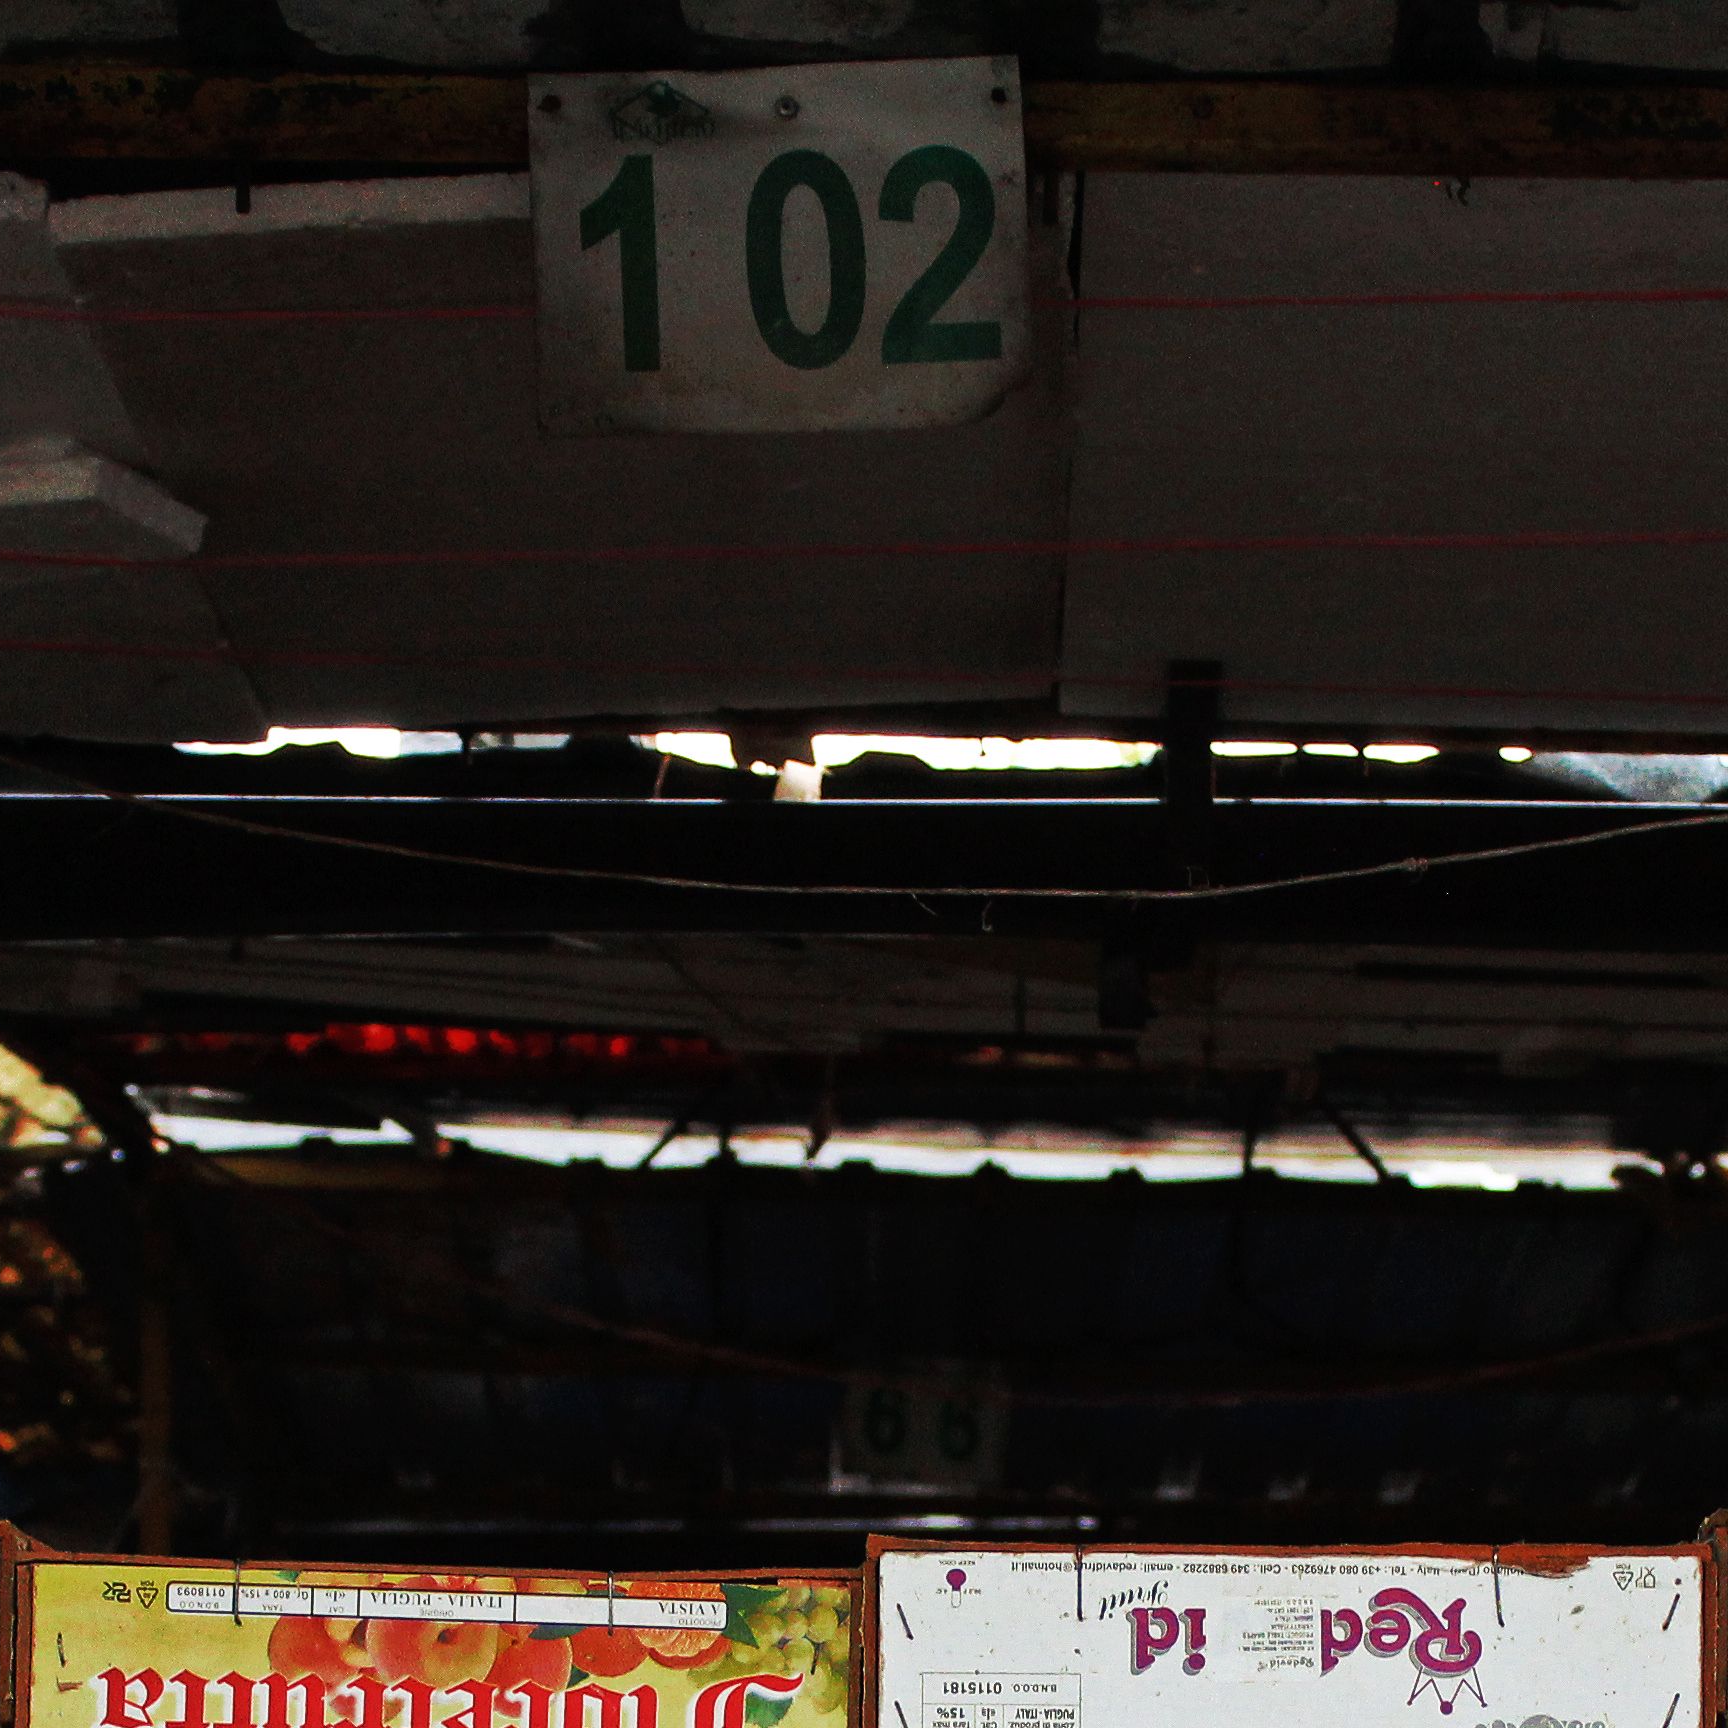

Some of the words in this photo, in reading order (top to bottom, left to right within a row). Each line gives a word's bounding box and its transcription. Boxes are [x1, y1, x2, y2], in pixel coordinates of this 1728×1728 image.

[579, 144, 1003, 373] 102
[176, 1586, 225, 1598] 0118093
[369, 1590, 432, 1607] PUGLIA
[447, 1592, 503, 1610] ITALIA
[943, 1682, 1001, 1694] 0115181
[937, 1708, 965, 1718] 15%
[1016, 1709, 1037, 1719] ITALY
[1044, 1709, 1074, 1719] PUGLIA
